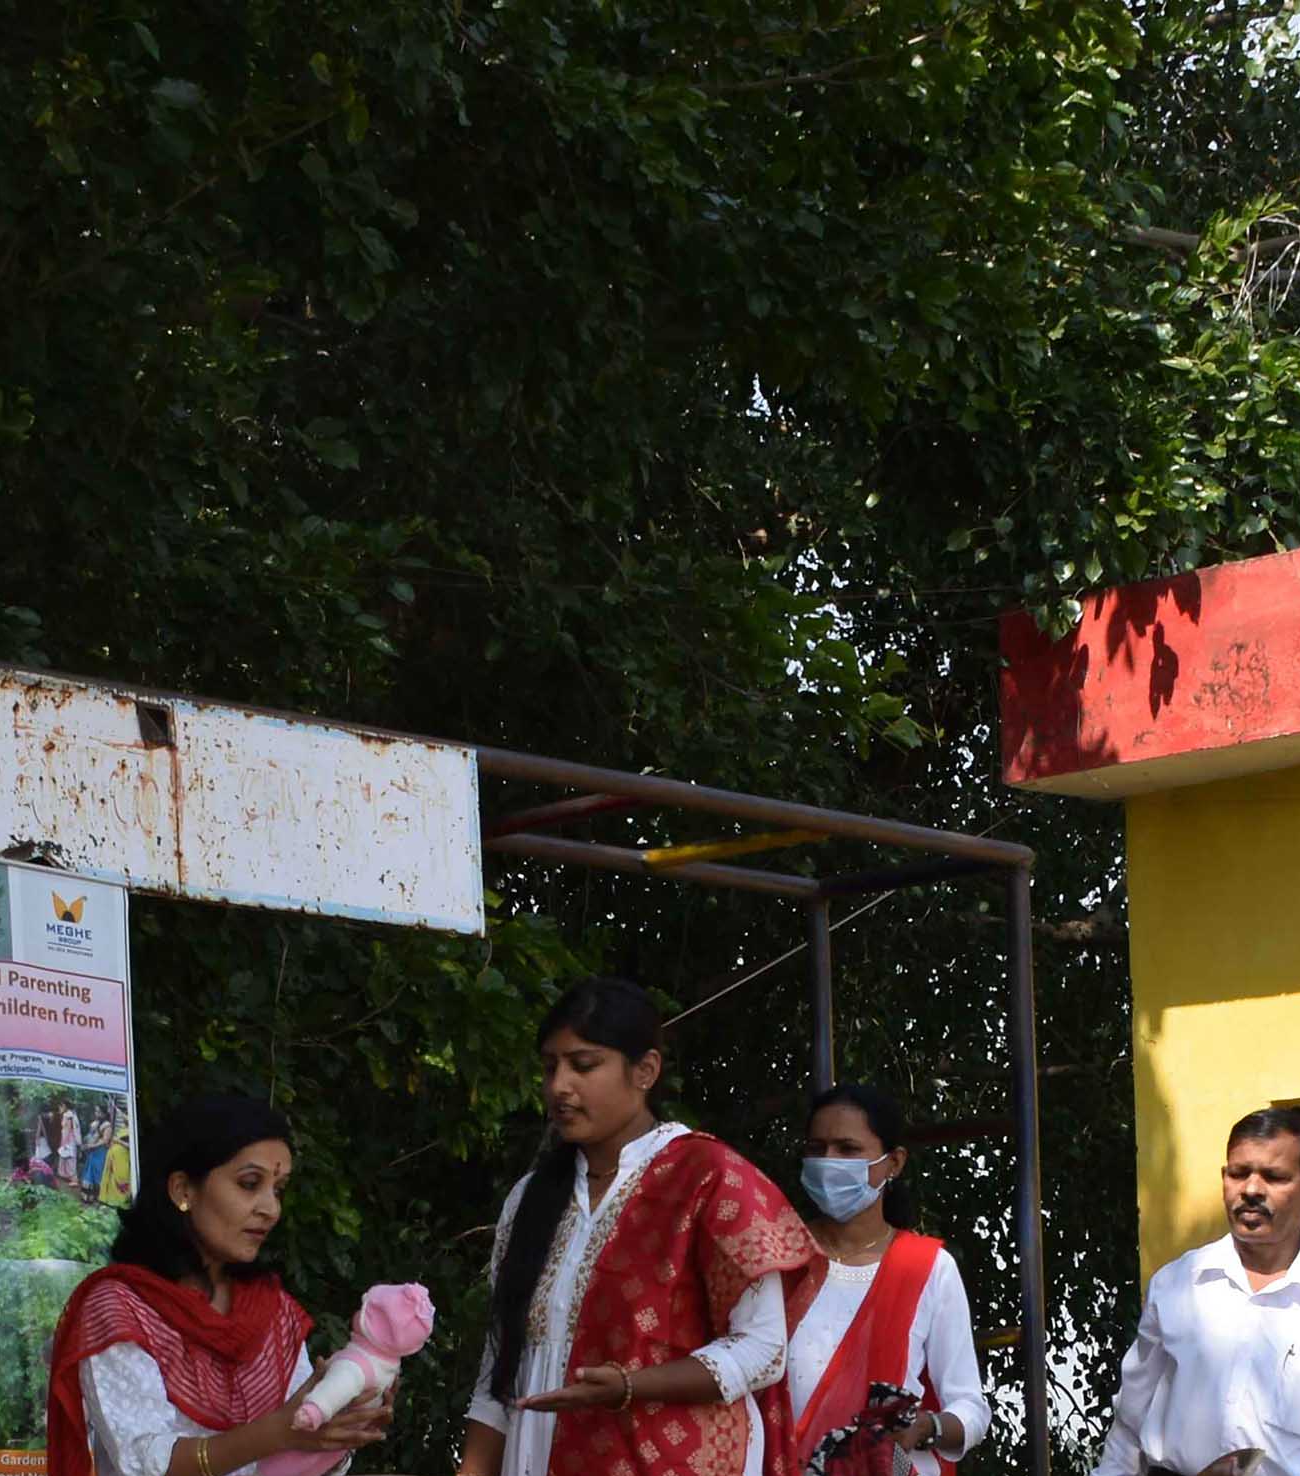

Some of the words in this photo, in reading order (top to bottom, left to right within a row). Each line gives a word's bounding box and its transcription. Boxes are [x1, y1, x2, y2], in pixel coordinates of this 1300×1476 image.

[8, 970, 91, 1003] Parenting
[63, 1008, 105, 1030] from
[10, 1053, 44, 1065] Program,
